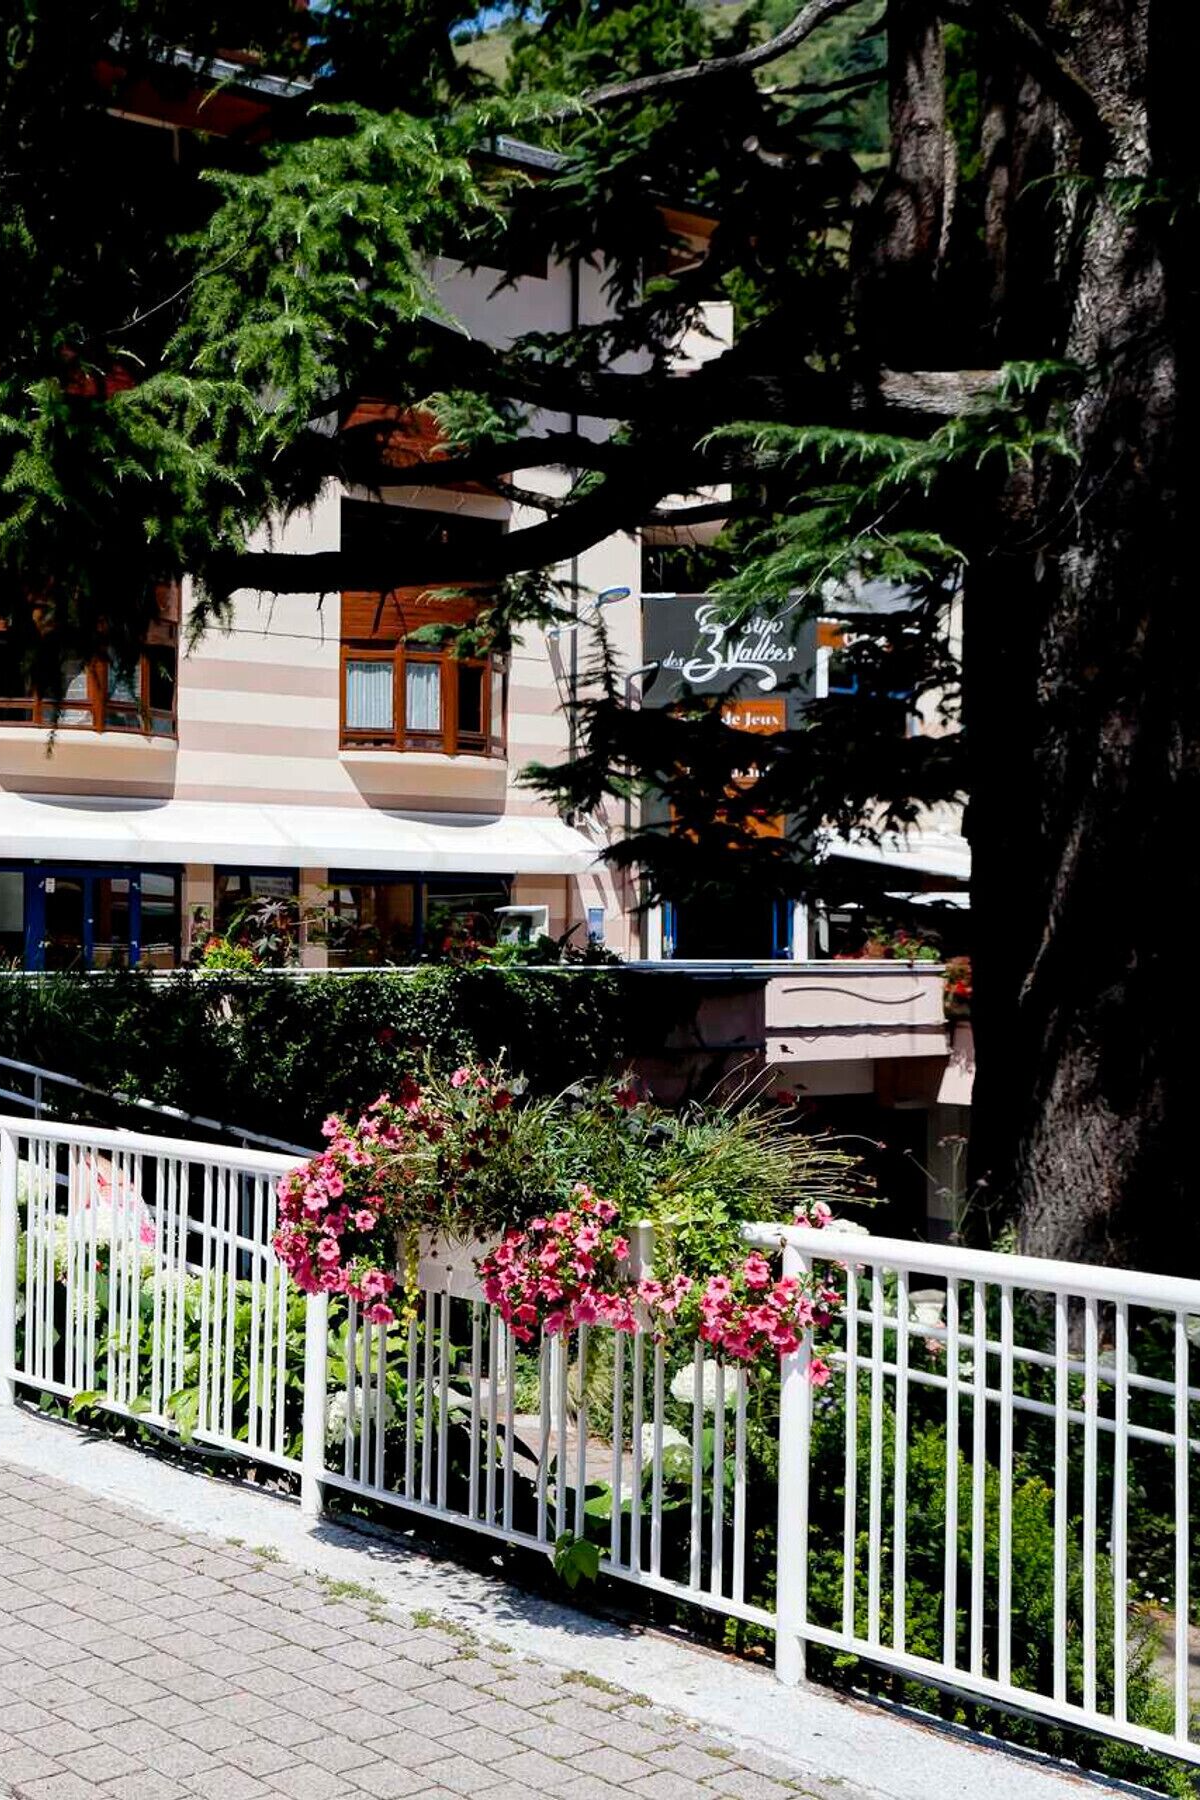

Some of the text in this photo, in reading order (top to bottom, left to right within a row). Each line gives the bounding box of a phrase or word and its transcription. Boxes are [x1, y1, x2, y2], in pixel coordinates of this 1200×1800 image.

[662, 623, 798, 684] des 3 Vallées
